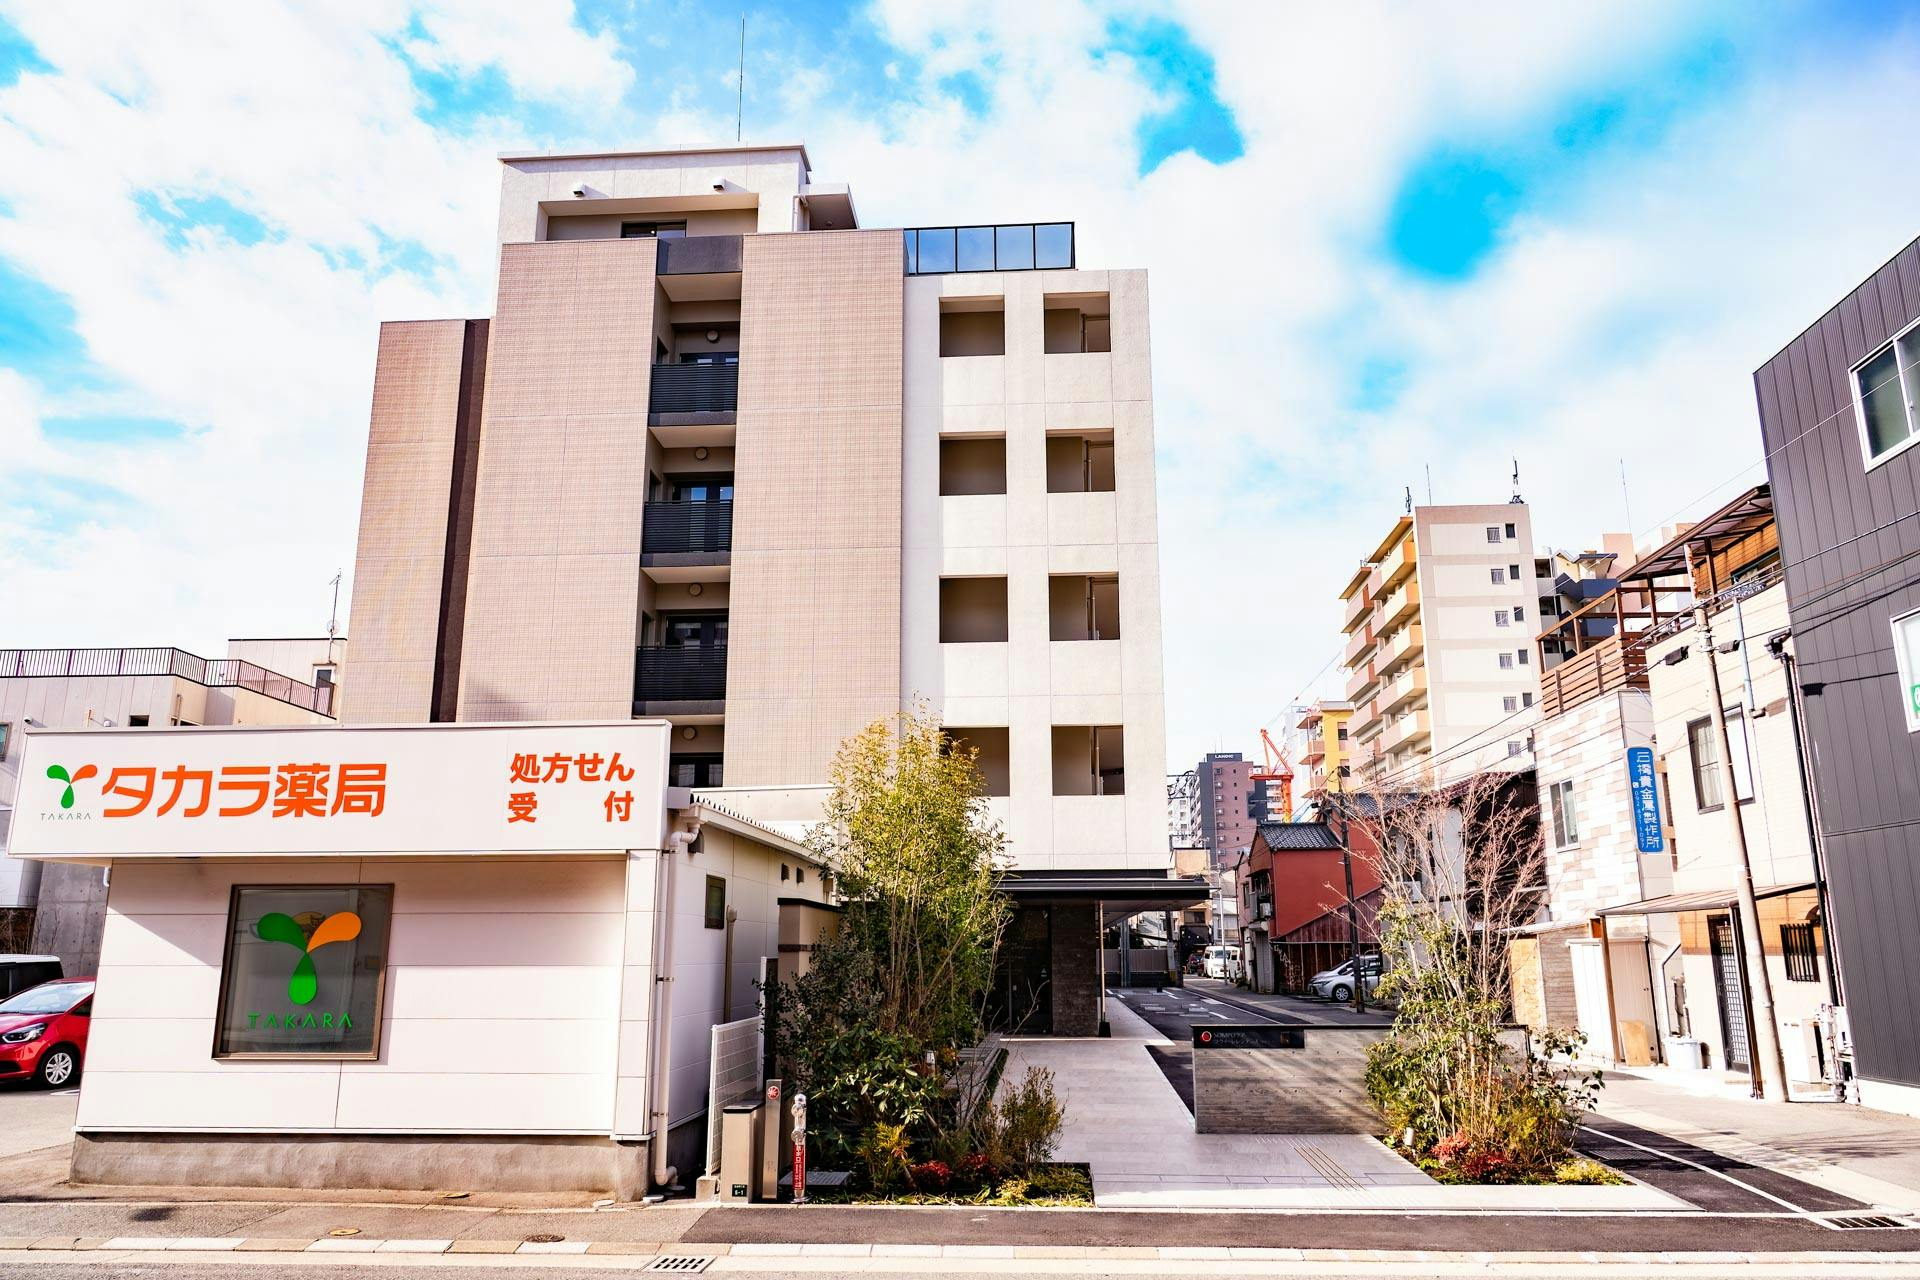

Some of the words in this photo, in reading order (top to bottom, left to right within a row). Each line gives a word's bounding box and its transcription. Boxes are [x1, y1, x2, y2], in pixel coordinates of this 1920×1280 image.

[509, 752, 635, 784] 処方せん
[101, 763, 388, 818] タカラ薬局
[40, 812, 92, 822] TAKARA
[248, 1012, 353, 1031] TAKARA
